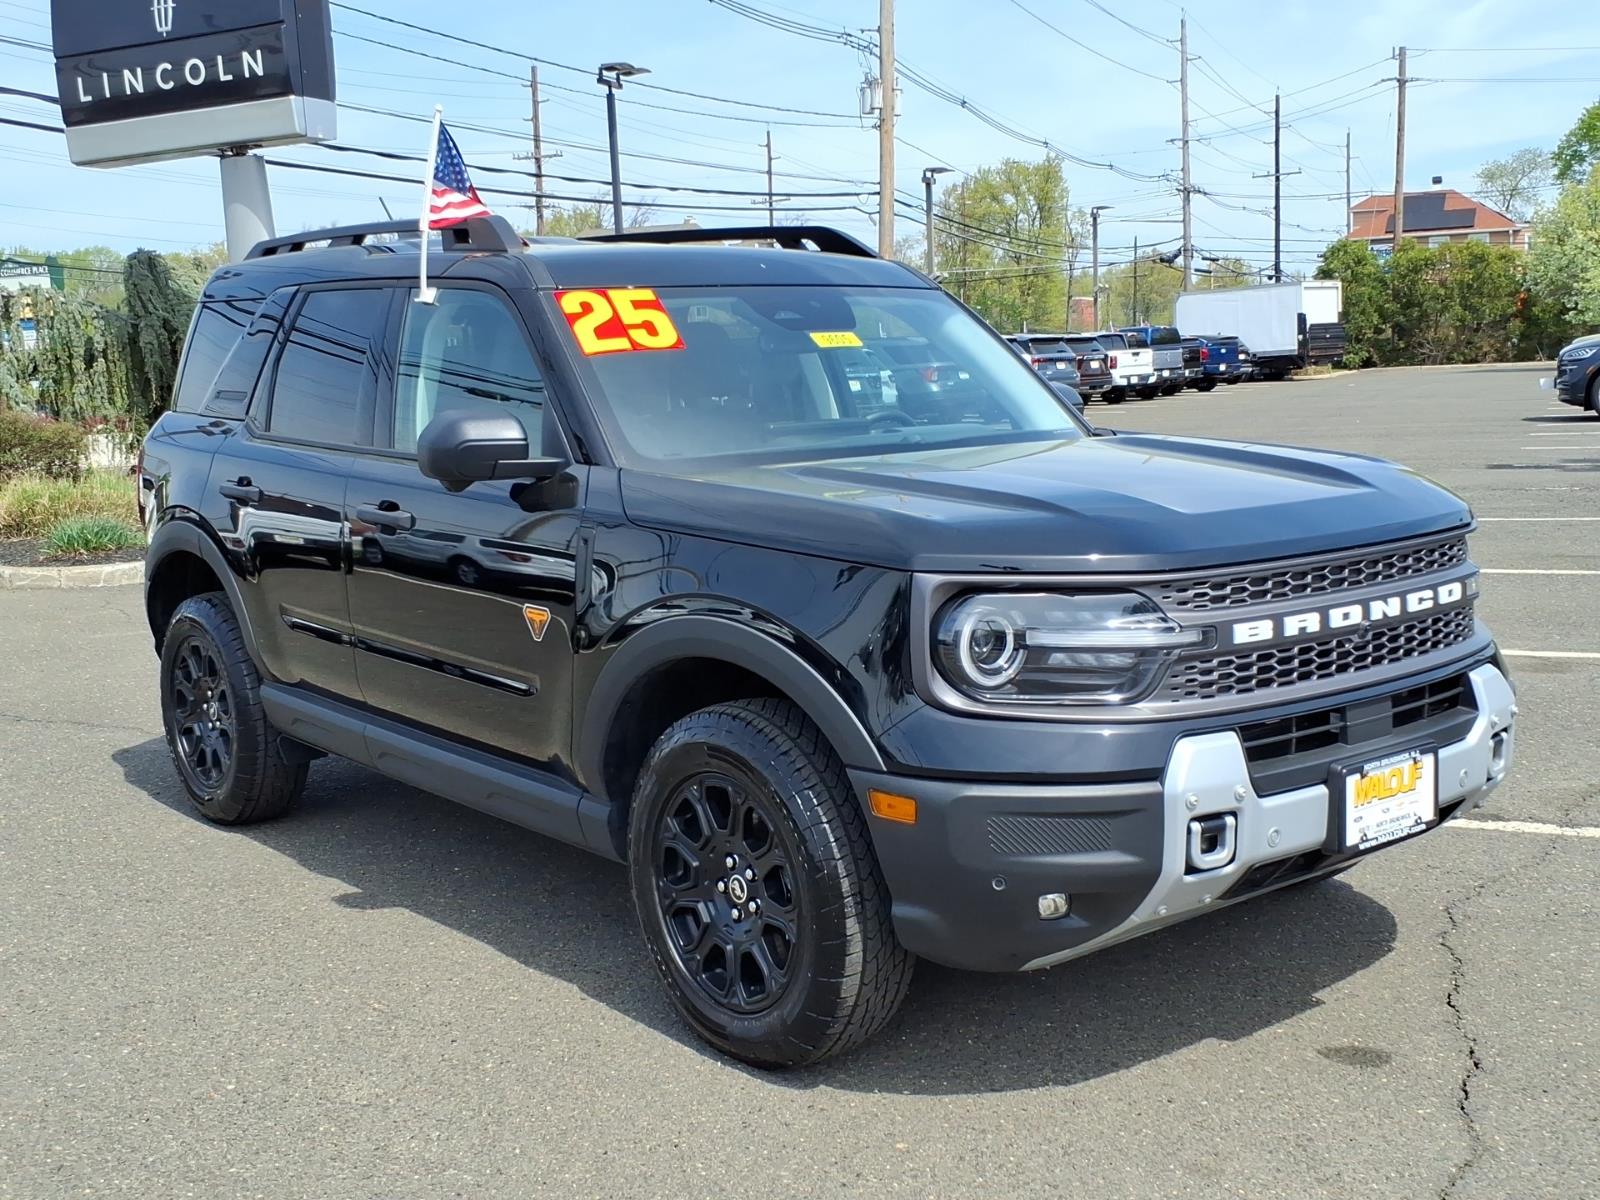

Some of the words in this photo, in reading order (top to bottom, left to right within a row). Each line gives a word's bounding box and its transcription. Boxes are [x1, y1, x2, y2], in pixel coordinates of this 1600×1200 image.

[77, 49, 264, 102] LINCOLN
[32, 265, 49, 275] PLACE
[560, 288, 680, 354] 25
[1232, 581, 1462, 645] BRONCO
[1353, 761, 1423, 808] MALOUF
